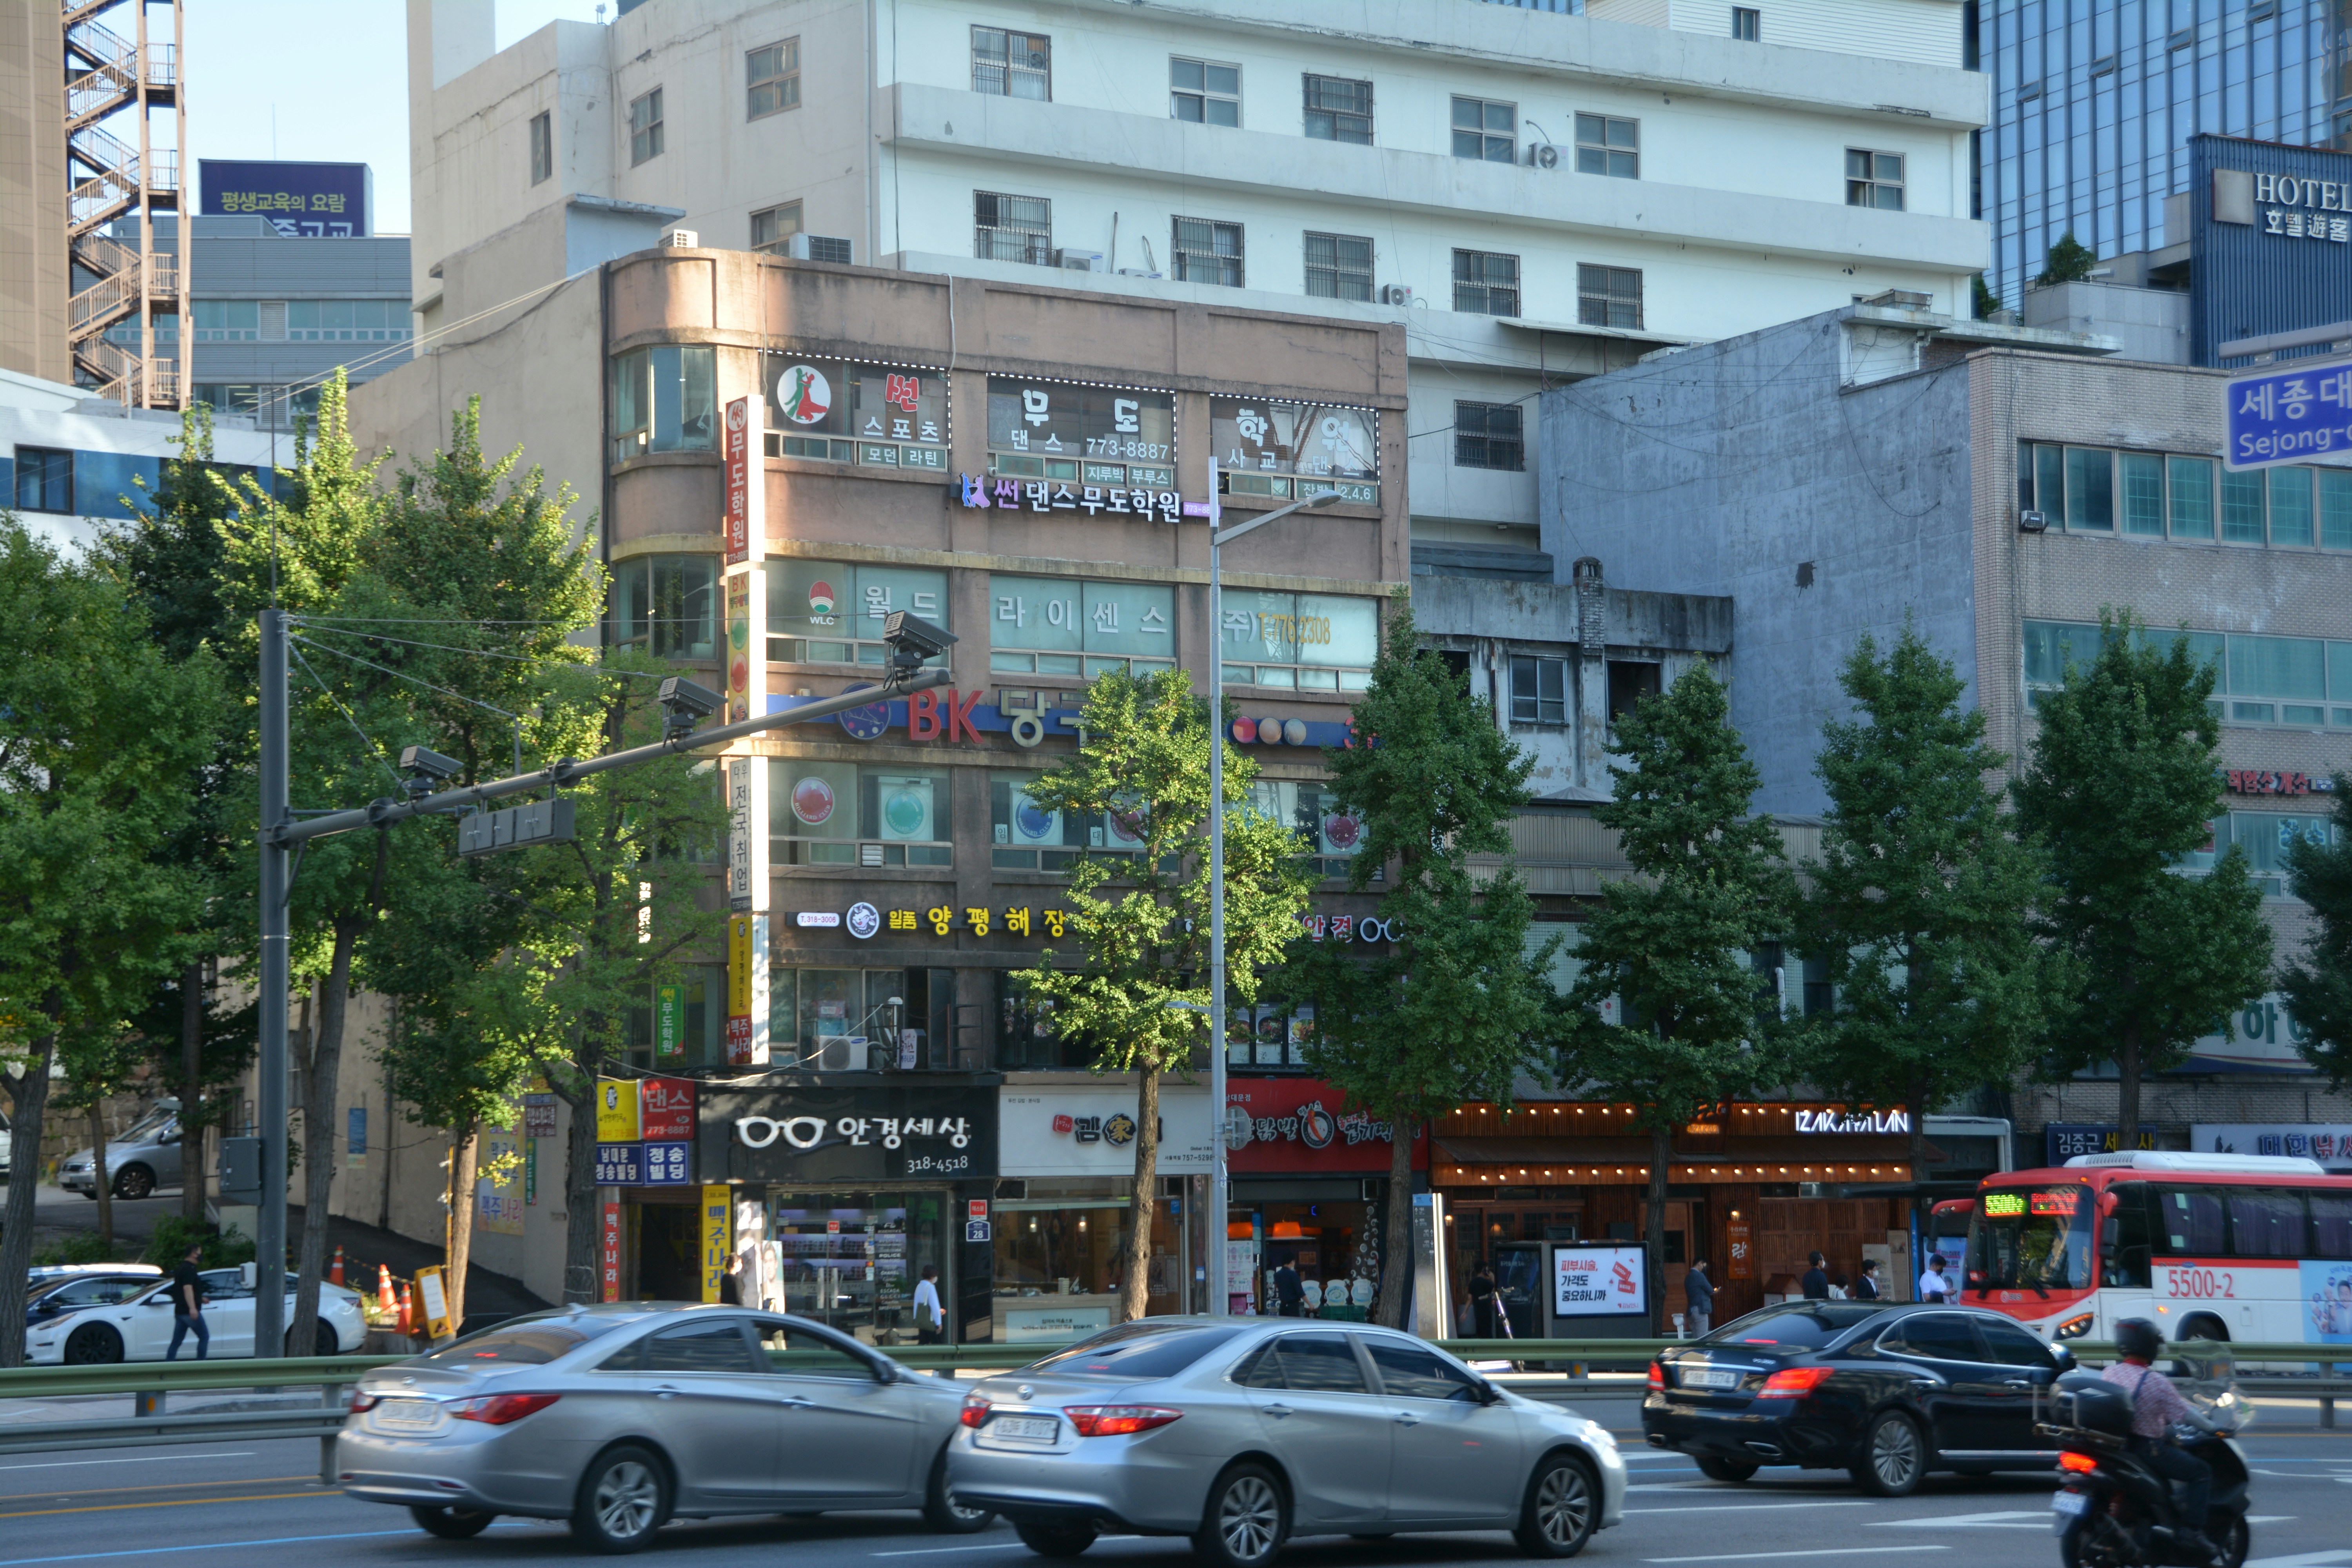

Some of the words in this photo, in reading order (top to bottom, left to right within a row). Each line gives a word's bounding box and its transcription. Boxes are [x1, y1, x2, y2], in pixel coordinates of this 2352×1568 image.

[221, 192, 305, 212] 평생교육의
[310, 193, 347, 213] 요람
[2255, 173, 2352, 212] HOTEL
[885, 374, 918, 412] 썬
[864, 417, 939, 442] 스포츠
[1011, 430, 1062, 452] 댄스
[1086, 437, 1169, 460] 773-8887
[868, 448, 897, 463] 모던
[909, 450, 937, 466] 라틴
[1228, 448, 1277, 469] 사교
[1312, 455, 1360, 477] 댄스
[1088, 466, 1125, 481] 지루박
[1131, 469, 1169, 485] 부루스
[731, 432, 744, 548] 무도학원
[1185, 504, 1219, 515] 773-88
[732, 575, 747, 592] BK
[865, 586, 939, 619] 월드
[809, 616, 835, 626] WLC
[998, 596, 1167, 633] 라이센스
[1299, 616, 1331, 645] 2308
[908, 688, 984, 744] BK
[2227, 770, 2309, 794] 직업소개소
[795, 802, 817, 820] BILLIARD
[819, 804, 831, 819] CLUB
[887, 814, 909, 832] BILLIARD
[1017, 817, 1038, 836] BILLIARD
[1039, 821, 1051, 835] CLUB
[736, 784, 747, 891] 전국취업
[997, 828, 1006, 839] 임
[1093, 830, 1101, 841] 대
[889, 909, 917, 930] 일품
[929, 905, 1102, 937] 양평해장
[1294, 914, 1352, 943] 안경
[646, 1089, 691, 1112] 댄스
[647, 1125, 690, 1135] 773-8887
[1250, 1117, 1298, 1142] 닭발
[1876, 1111, 1908, 1132] LAN
[836, 1117, 971, 1149] 안경세상
[2058, 1133, 2100, 1154] 김중근
[2104, 1132, 2154, 1151] 세사
[601, 1148, 629, 1163] 남대문
[907, 1155, 969, 1173] 318-4518
[649, 1164, 684, 1180] 빌딩
[973, 1230, 984, 1239] 28
[604, 1214, 618, 1283] 맥주나라
[708, 1204, 726, 1288] 맥주나라
[1560, 1260, 1599, 1272] 피부시술,
[1561, 1275, 1589, 1287] 가격도
[2169, 1269, 2234, 1298] 5500-2
[1561, 1290, 1607, 1302] 중요하니까
